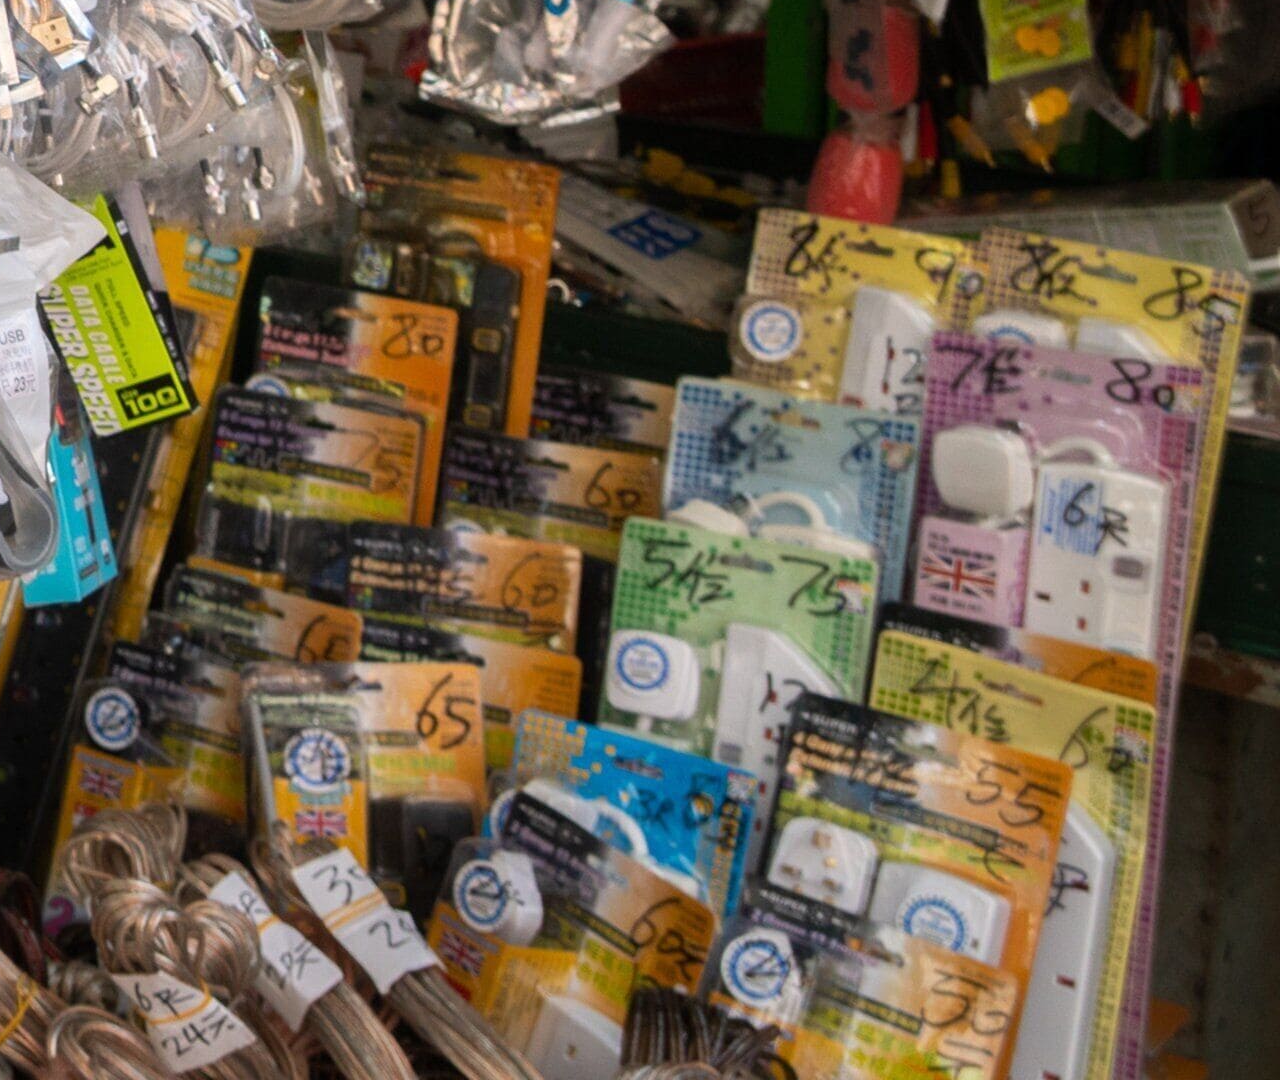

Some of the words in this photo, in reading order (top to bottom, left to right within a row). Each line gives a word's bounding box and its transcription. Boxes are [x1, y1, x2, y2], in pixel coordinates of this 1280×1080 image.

[39, 283, 89, 360] SUPER
[69, 362, 124, 437] SPEED
[70, 285, 102, 328] DATA
[88, 332, 126, 385] CABLE
[781, 555, 861, 618] 75
[416, 672, 476, 750] 65
[966, 759, 1063, 828] 55
